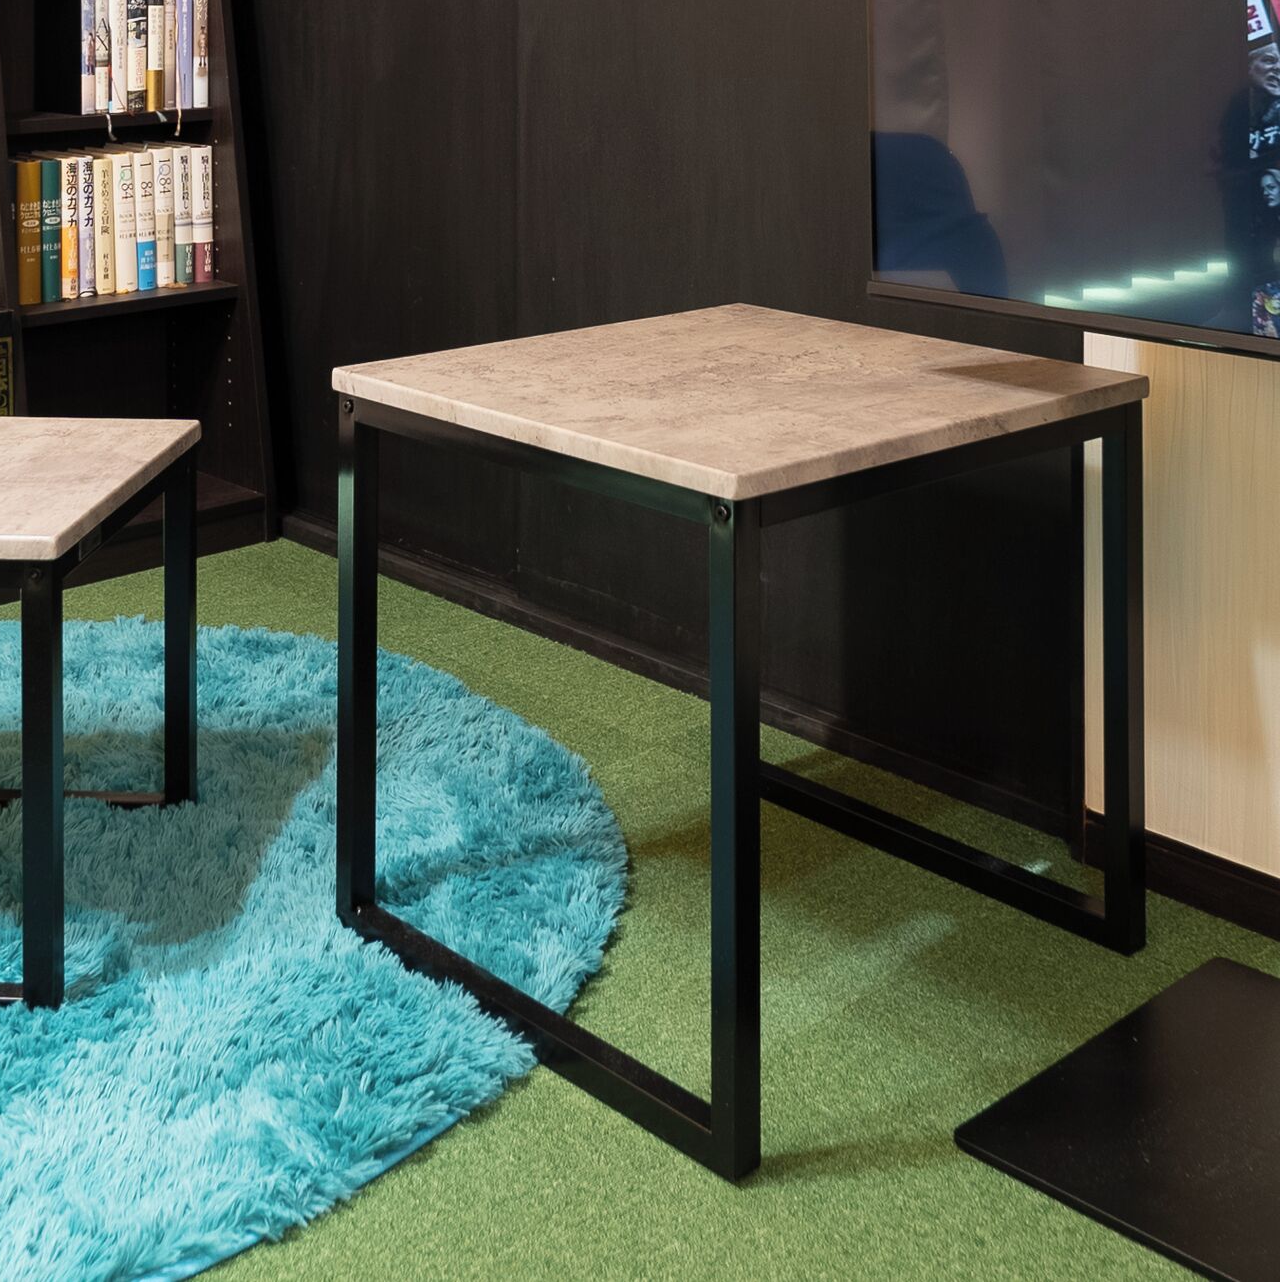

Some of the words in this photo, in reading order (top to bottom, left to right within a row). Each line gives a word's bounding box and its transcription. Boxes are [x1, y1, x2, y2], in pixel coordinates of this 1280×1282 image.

[66, 162, 77, 228] 海辺のカフカ
[83, 161, 94, 228] 海辺のカフカ
[119, 163, 134, 200] 1Q84
[140, 161, 153, 199] 184
[158, 158, 171, 194] 1Q84
[180, 155, 190, 209] 騎士団長殺し
[200, 155, 211, 209] 騎士団長殺し
[100, 168, 110, 236] 羊をめぐる冒険
[102, 253, 110, 280] 村上春樹
[185, 244, 193, 274] 村上春樹
[204, 243, 212, 272] 村上春樹
